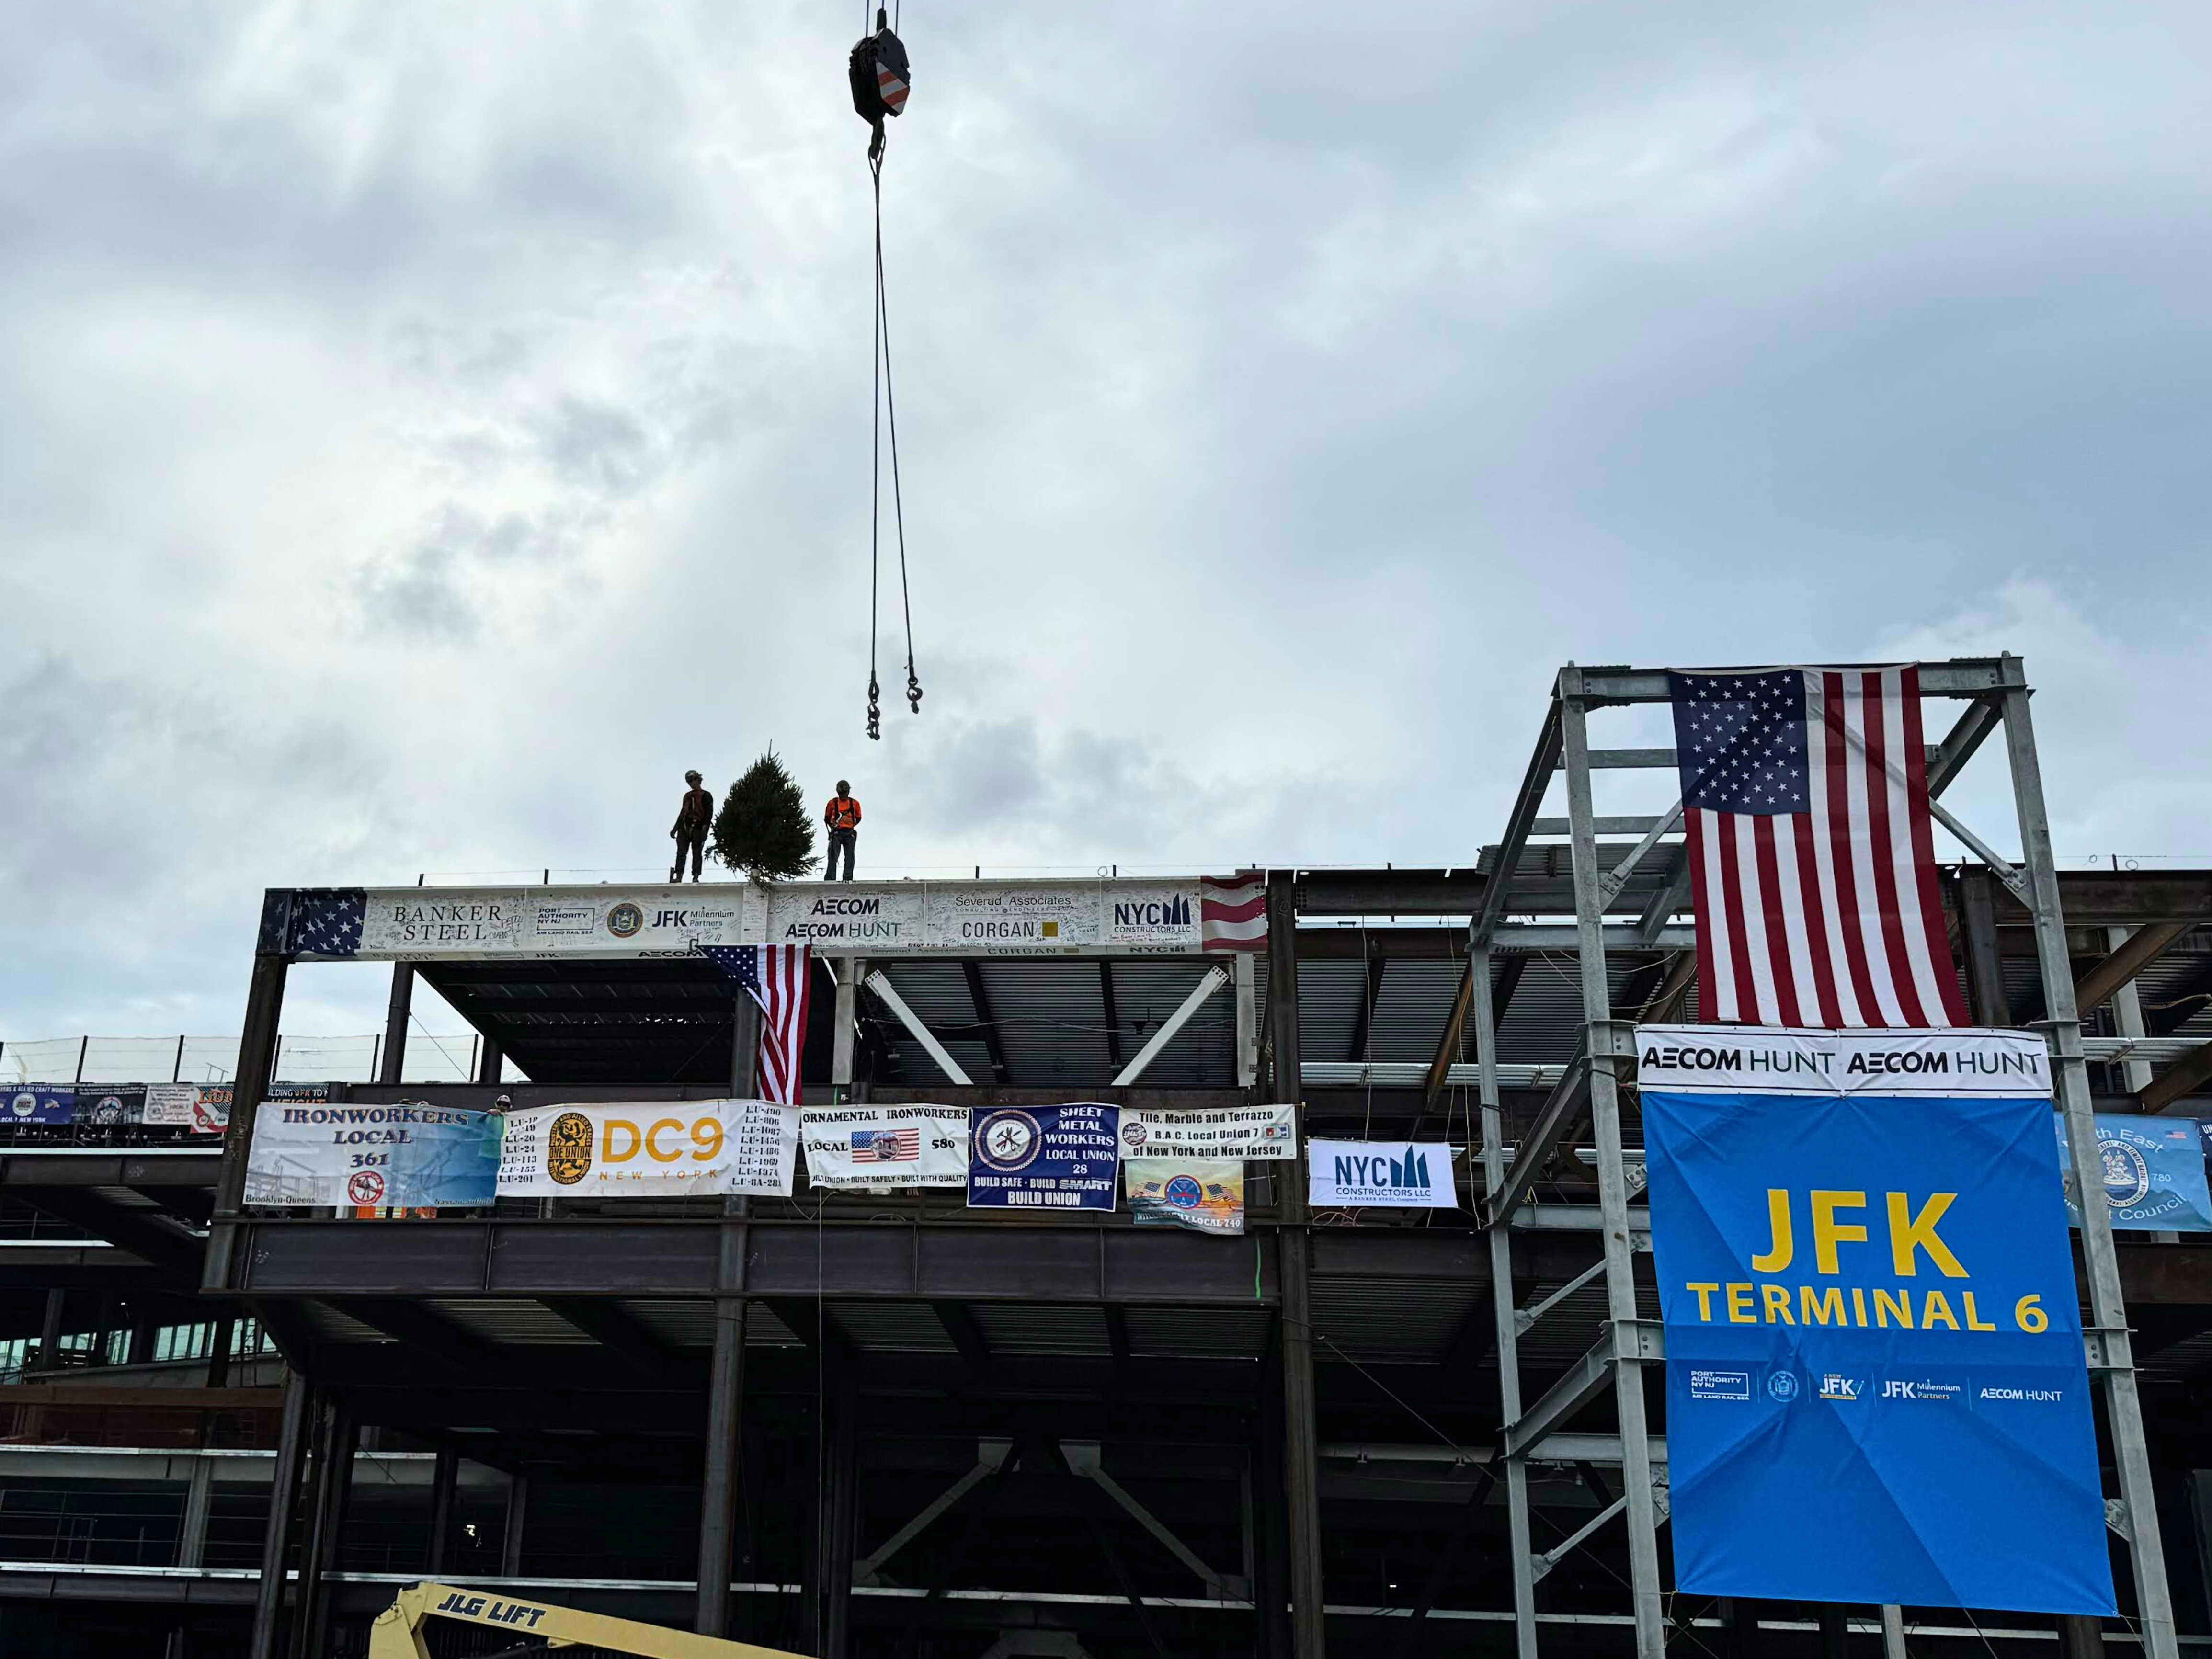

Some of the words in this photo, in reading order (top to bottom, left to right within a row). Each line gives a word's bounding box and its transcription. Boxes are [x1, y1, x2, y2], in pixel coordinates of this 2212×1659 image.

[811, 899, 879, 915] AECOM
[956, 897, 1002, 906] Severud
[1009, 896, 1071, 906] Associates
[393, 905, 502, 922] BANKER
[652, 910, 688, 927] JFK
[690, 909, 734, 918] Millennium
[1115, 904, 1160, 925] NYC
[404, 924, 488, 940] STEEL
[785, 923, 844, 938] AECOM
[849, 922, 902, 937] HUNT
[963, 922, 1034, 937] CORGAN
[1642, 1047, 1741, 1071] AECOM
[1750, 1050, 1836, 1073] HUNT
[1847, 1052, 1948, 1073] AECOM
[1957, 1052, 2042, 1075] HUNT
[283, 1108, 468, 1125] IRONWORKERS
[803, 1111, 878, 1123] ORNAMENTAL
[887, 1108, 967, 1119] IRONWORKERS
[1060, 1107, 1104, 1117] SHEET
[1165, 1114, 1202, 1124] Marble
[1206, 1113, 1225, 1123] and
[1228, 1111, 1273, 1122] Terrazzo
[1059, 1120, 1103, 1131] METAL
[333, 1130, 413, 1144] LOCAL
[602, 1117, 724, 1163] DC9
[1045, 1134, 1115, 1146] WORKERS
[1155, 1131, 1185, 1140] B.A.C.
[1188, 1130, 1216, 1140] Local
[1220, 1129, 1250, 1138] Union
[1253, 1128, 1258, 1137] 7
[2120, 1129, 2164, 1153] East
[549, 1147, 563, 1158] ONE
[566, 1147, 590, 1158] UNION
[807, 1142, 848, 1152] LOCAL
[931, 1139, 955, 1149] 580
[1133, 1146, 1144, 1156] of
[1147, 1146, 1168, 1156] New
[1172, 1146, 1195, 1156] York
[1198, 1147, 1218, 1157] and
[1221, 1146, 1243, 1156] New
[1247, 1146, 1281, 1157] Jersey
[350, 1153, 390, 1168] 361
[1046, 1150, 1079, 1159] LOCAL
[1083, 1150, 1115, 1161] UNION
[600, 1171, 642, 1181] NEW
[662, 1169, 717, 1180] YORK
[1073, 1164, 1088, 1174] 28
[1335, 1156, 1387, 1187] NYC
[825, 1175, 845, 1183] UNION
[974, 1177, 1000, 1187] BUILD
[1001, 1177, 1022, 1187] SAFE
[1030, 1178, 1056, 1189] BUILD
[1059, 1179, 1112, 1191] SMART
[2153, 1173, 2171, 1182] 780
[245, 1194, 316, 1204] Brooklyn-Queens
[1008, 1191, 1042, 1204] BUILD
[1045, 1192, 1080, 1205] UNION
[1336, 1188, 1412, 1196] CONSTRUCTORS
[2119, 1193, 2187, 1220] Council
[1190, 1216, 1222, 1227] LOCAL
[1752, 1188, 1971, 1278] JFK
[1686, 1282, 1996, 1332] TERMINAL
[2015, 1294, 2049, 1334] 6
[1820, 1378, 1855, 1395] JFK
[1882, 1381, 1916, 1398] JFK
[1917, 1379, 1961, 1391] Millennium
[1980, 1388, 2023, 1400] AECOM
[2026, 1389, 2063, 1402] HUNT
[437, 1593, 487, 1616] JLG
[488, 1602, 546, 1627] LIFT
